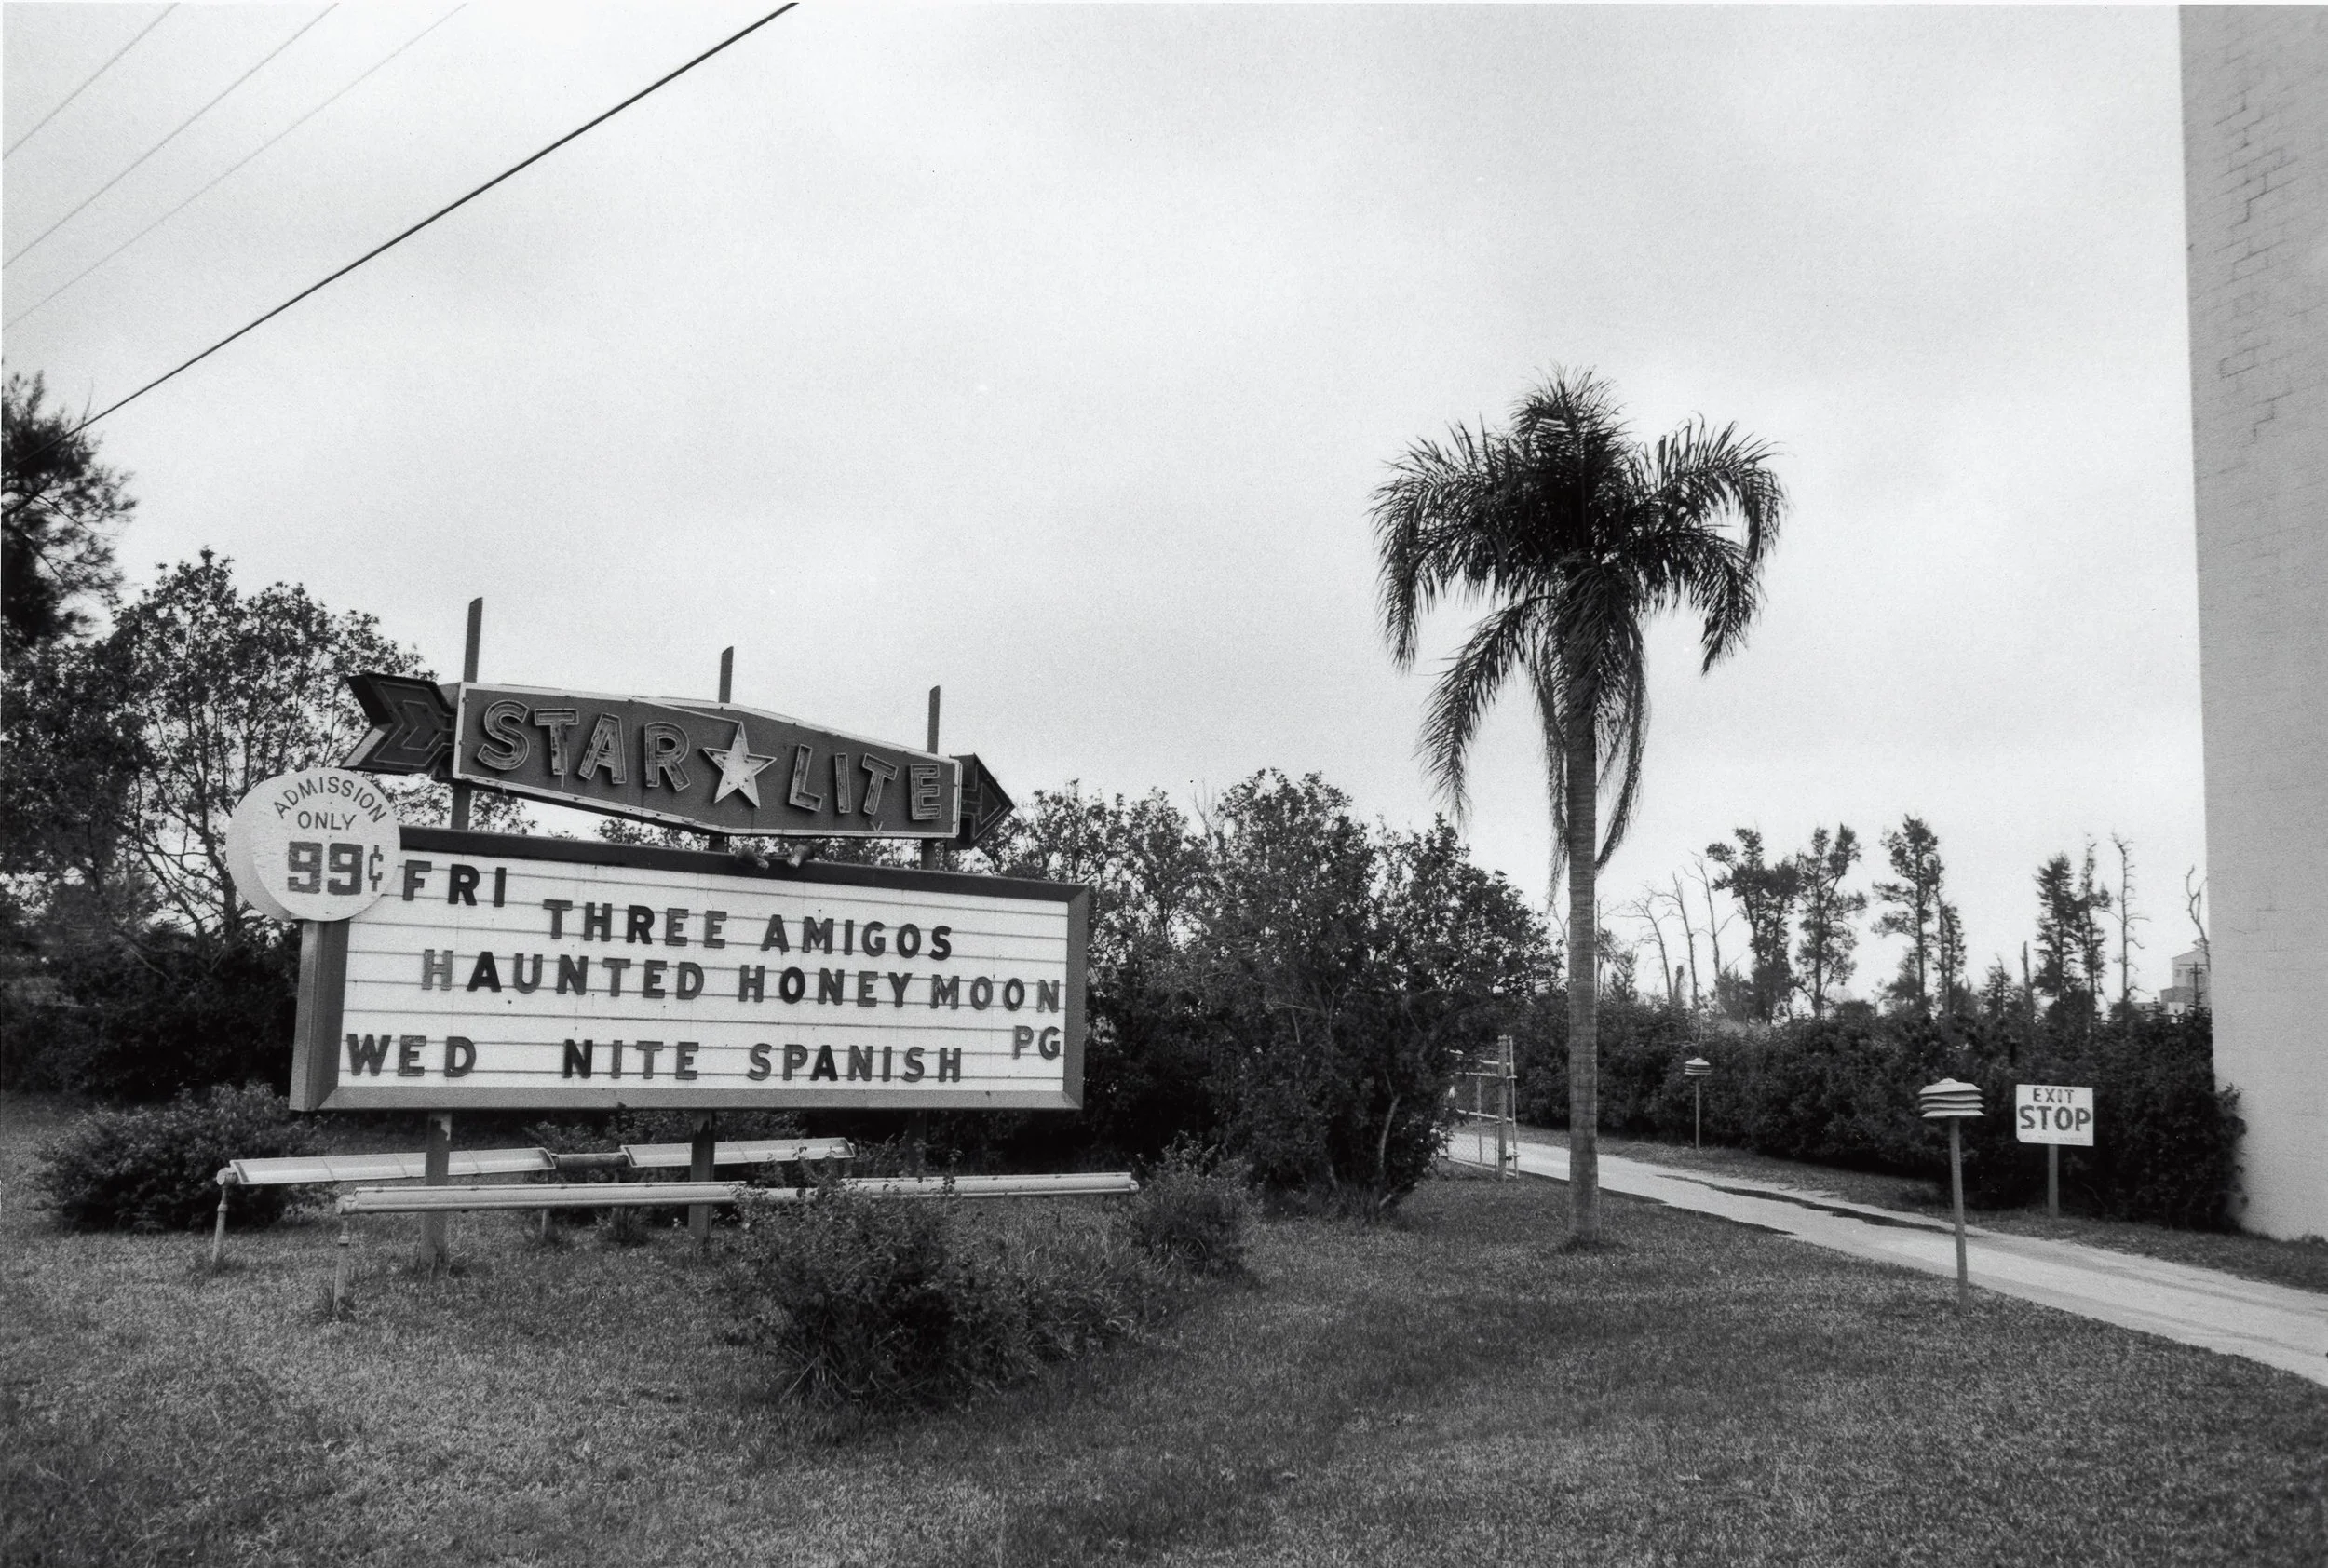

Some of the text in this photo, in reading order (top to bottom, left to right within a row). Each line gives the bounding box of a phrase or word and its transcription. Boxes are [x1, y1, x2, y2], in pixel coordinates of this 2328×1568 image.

[476, 699, 943, 821] STAR LITE
[274, 776, 387, 823] ADMISSION
[297, 810, 357, 831] ONLY
[287, 841, 384, 896] 99¢
[402, 859, 507, 908] FRI
[543, 899, 953, 961] THREE AMIGOS
[421, 948, 705, 1000] HAUNTED
[346, 1034, 961, 1083] WED NITE SPANISH
[1011, 1025, 1061, 1061] PG
[2019, 1104, 2091, 1132] STOP
[2033, 1088, 2075, 1104] EXIT
